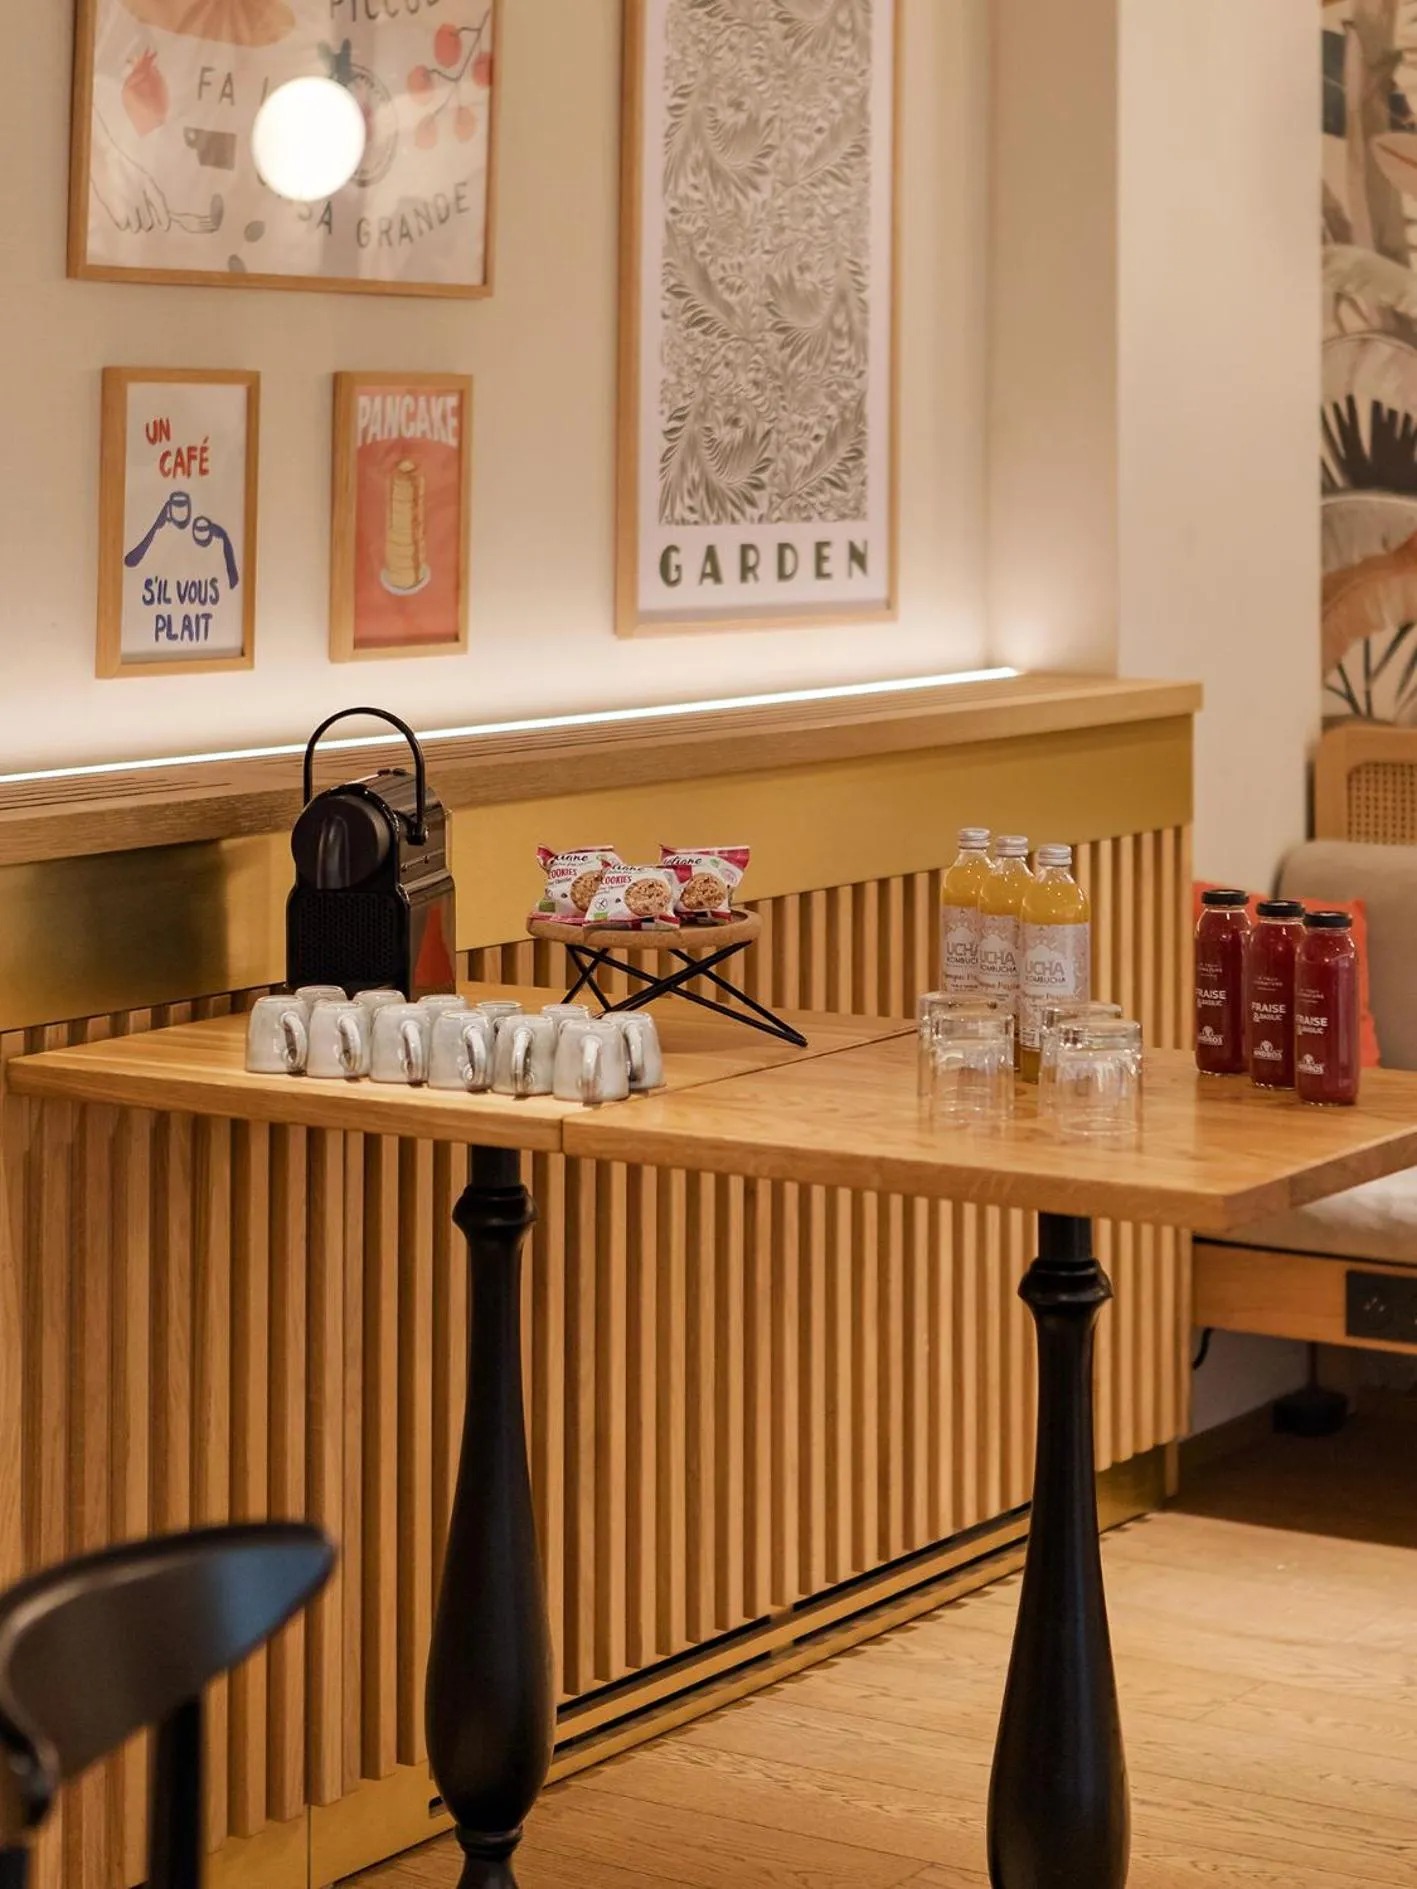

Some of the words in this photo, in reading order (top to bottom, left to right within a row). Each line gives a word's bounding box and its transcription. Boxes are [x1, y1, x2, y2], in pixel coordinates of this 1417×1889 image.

[356, 181, 471, 250] GRANDE
[145, 416, 172, 446] UN
[356, 394, 460, 448] PANCAKE
[159, 436, 211, 479] CAFÉ
[658, 539, 869, 589] GARDEN
[141, 577, 172, 606] S'IL
[176, 576, 220, 606] VOUS
[154, 613, 213, 643] PLAIT
[1251, 1001, 1287, 1015] FRAISE
